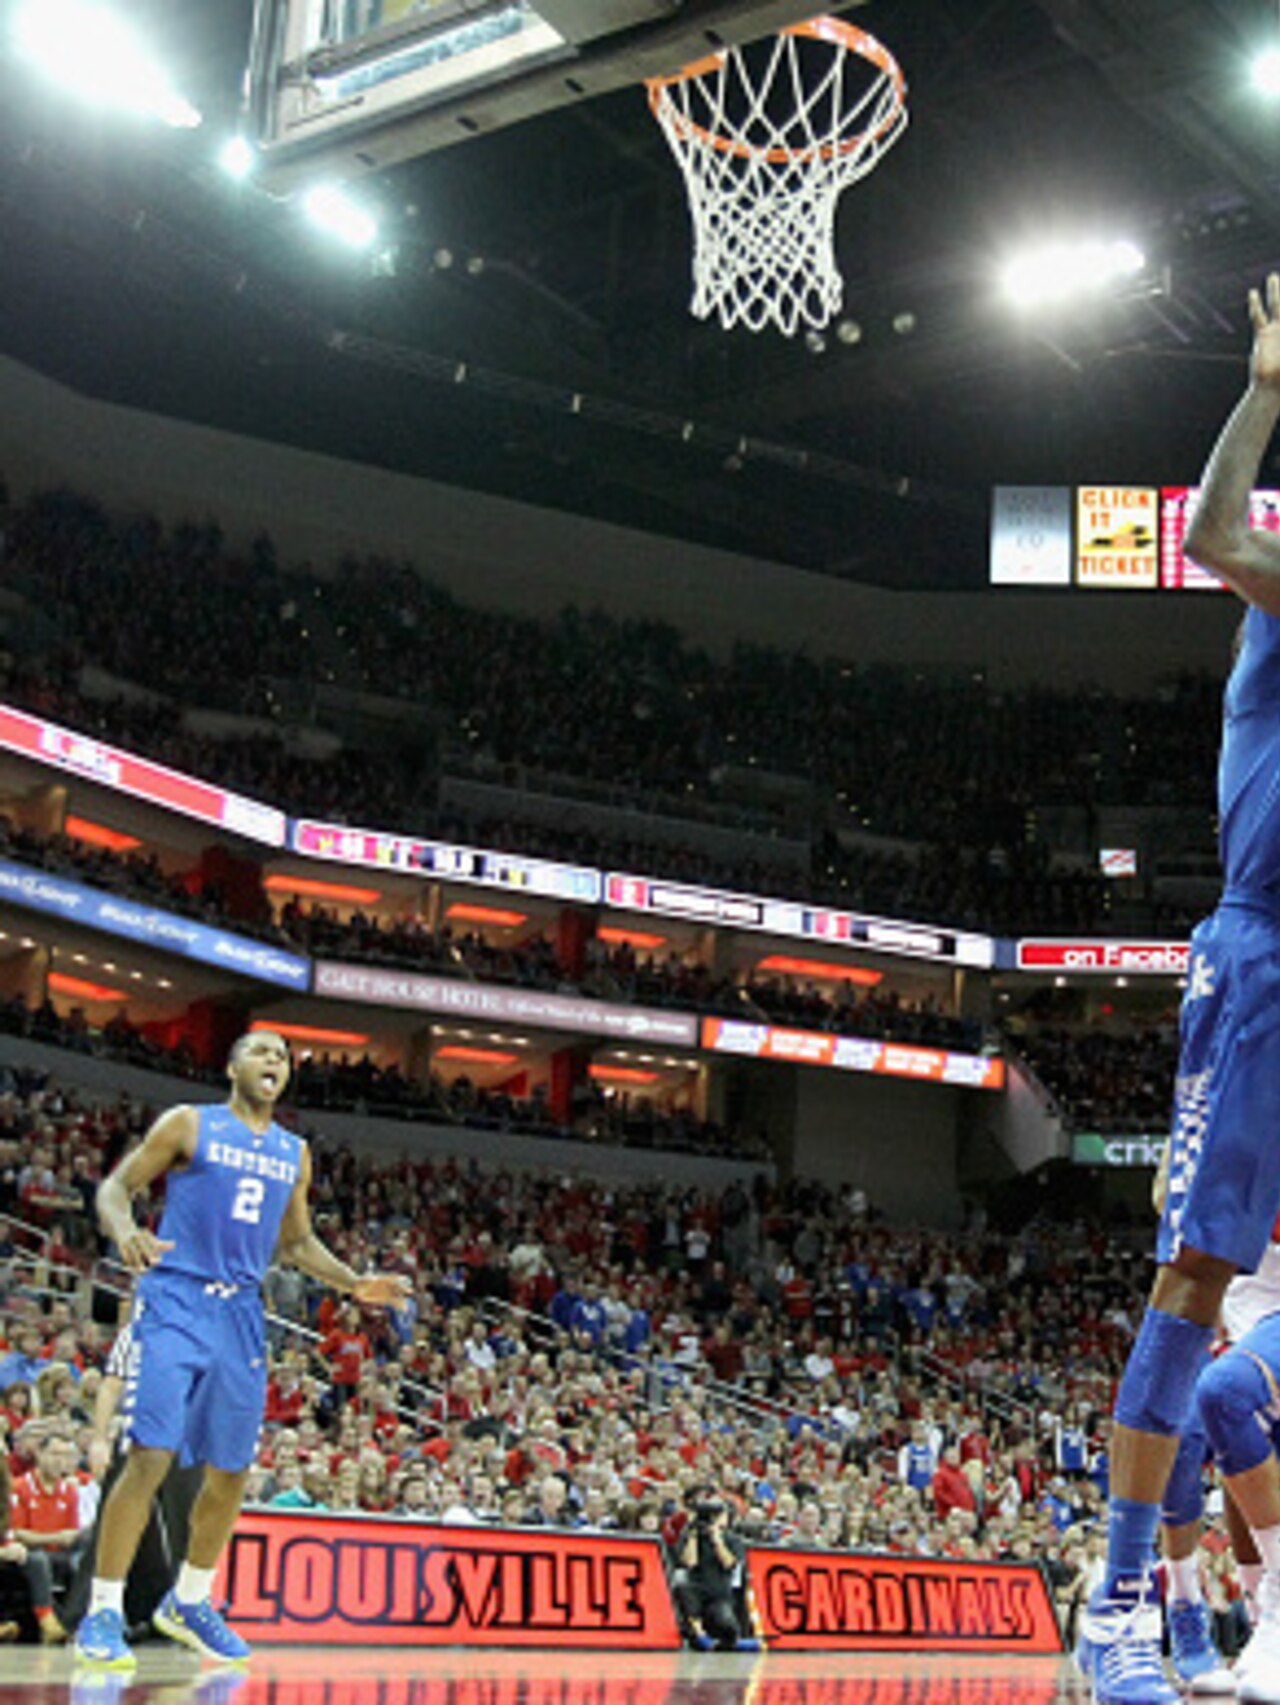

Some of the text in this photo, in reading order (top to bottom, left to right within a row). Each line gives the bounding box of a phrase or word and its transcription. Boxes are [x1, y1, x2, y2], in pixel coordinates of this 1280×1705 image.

[1079, 556, 1156, 576] TICKET
[1063, 949, 1097, 968] on
[206, 1140, 297, 1185] KENTUCKY
[231, 1176, 265, 1225] 2
[226, 1534, 645, 1631] LOUISVILLE
[766, 1563, 1036, 1638] CARDINALS
